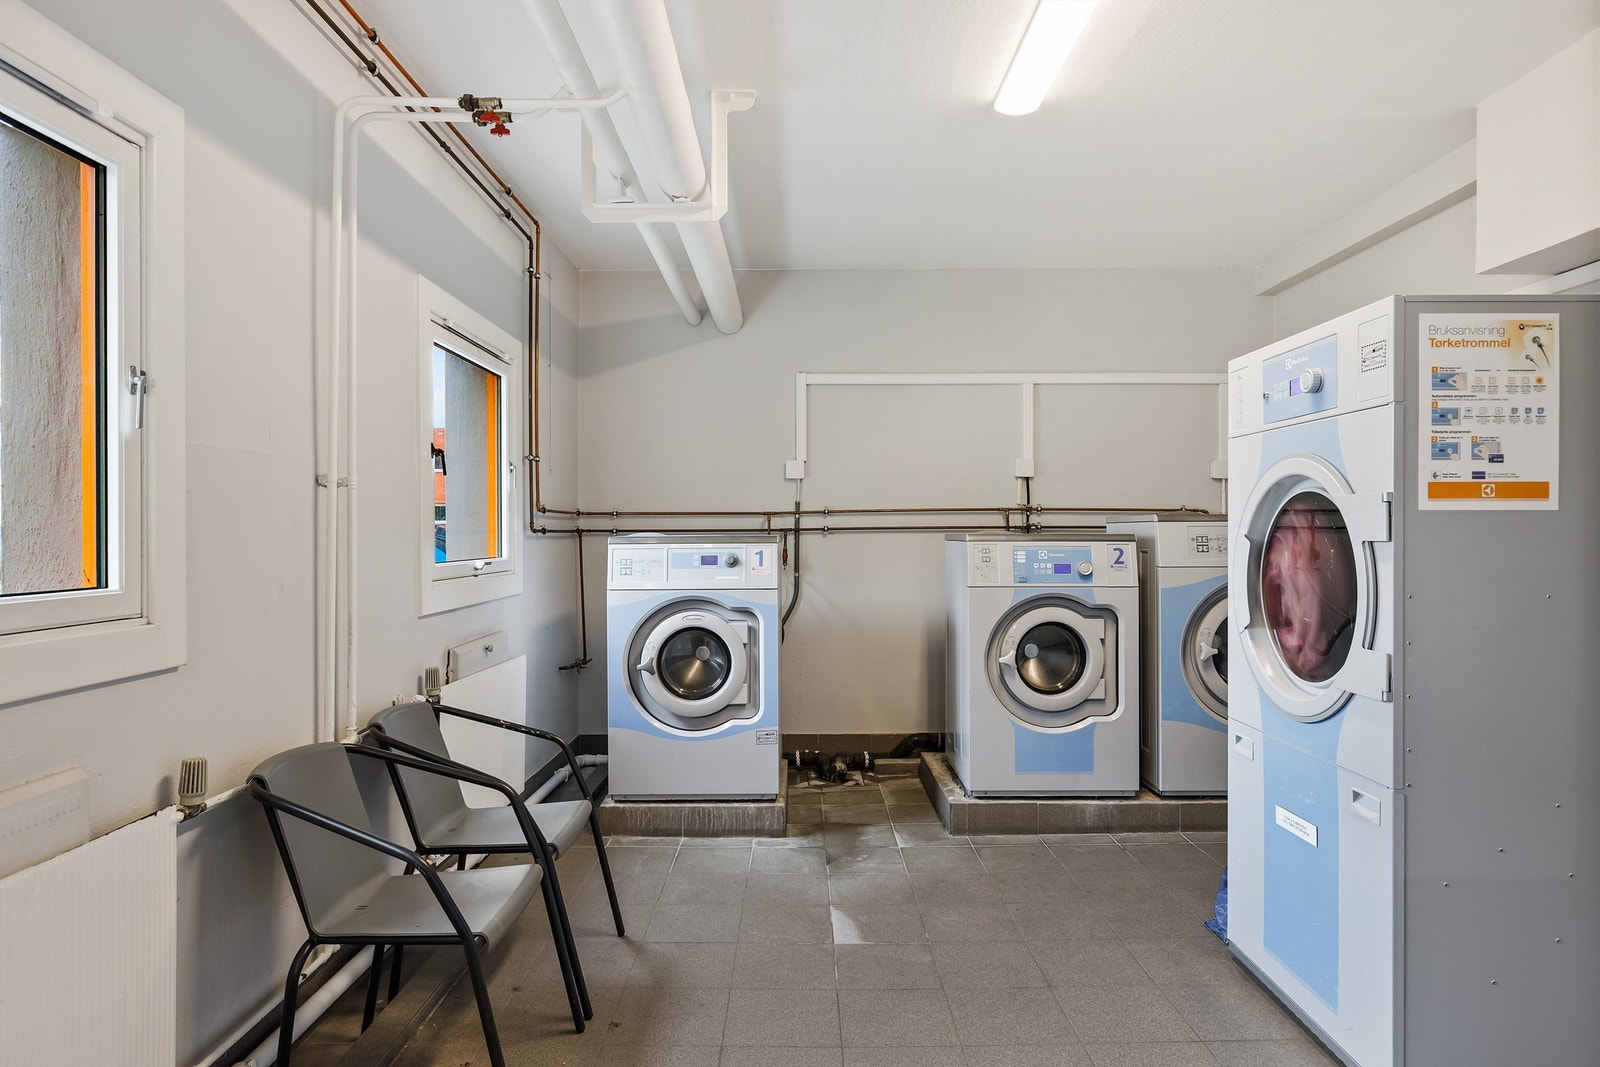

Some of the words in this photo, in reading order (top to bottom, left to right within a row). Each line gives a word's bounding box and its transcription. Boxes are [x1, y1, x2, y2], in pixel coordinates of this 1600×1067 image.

[1428, 324, 1506, 338] Bruksanvisning
[1428, 337, 1511, 348] Tørketrommel
[755, 550, 764, 567] 1
[1113, 547, 1125, 565] 2
